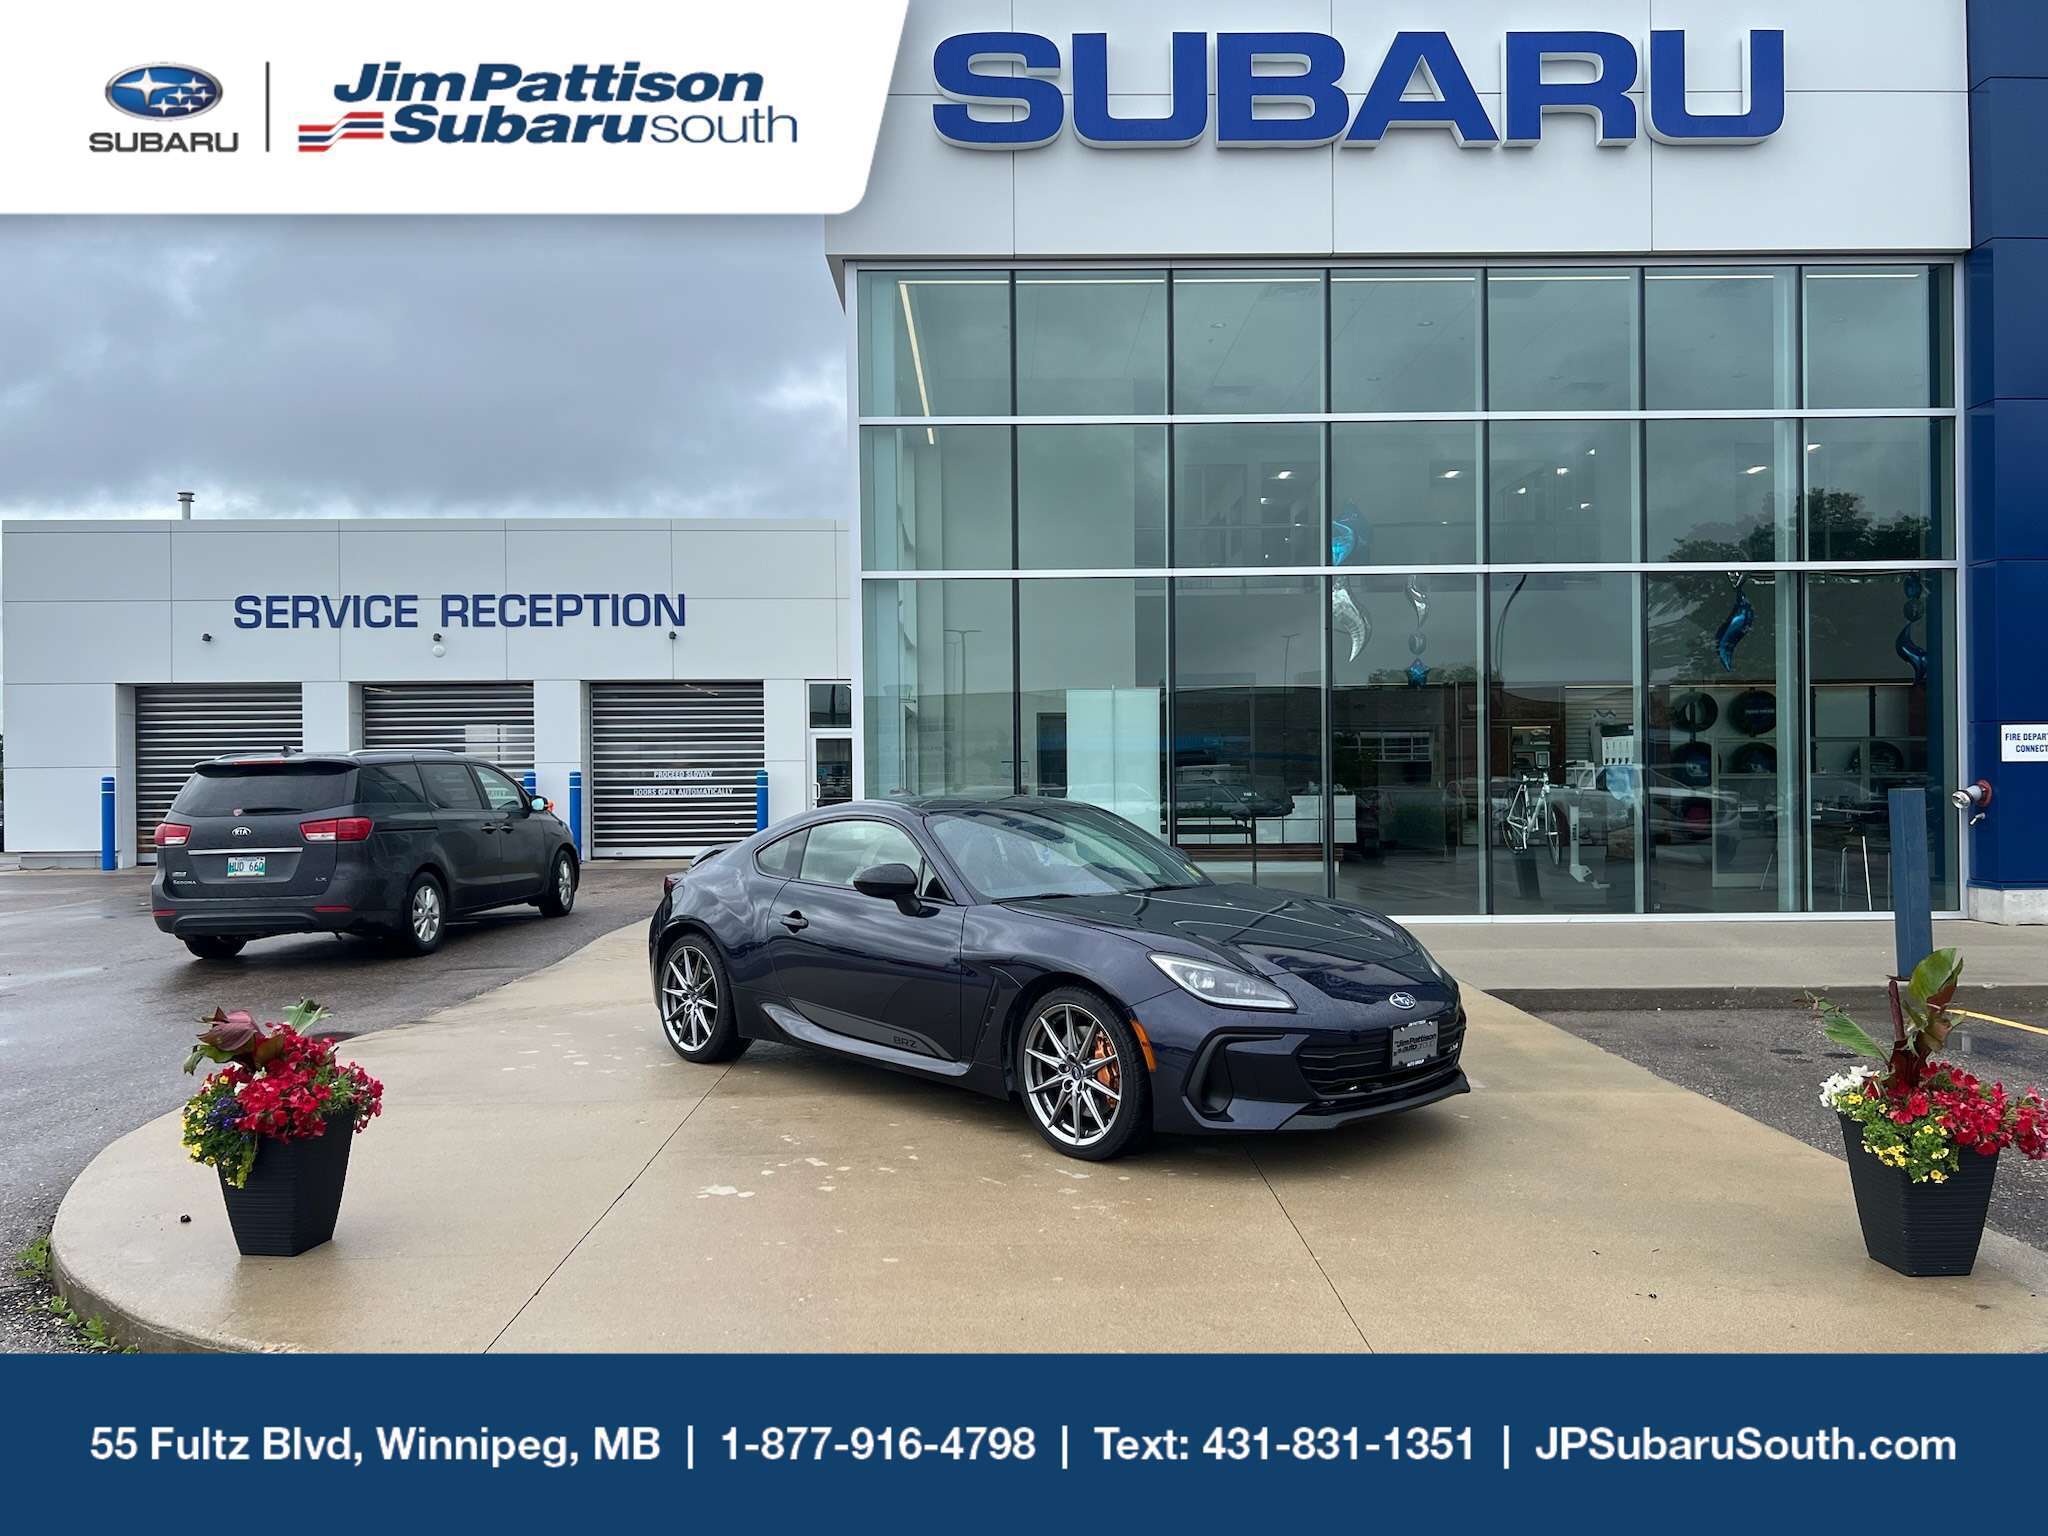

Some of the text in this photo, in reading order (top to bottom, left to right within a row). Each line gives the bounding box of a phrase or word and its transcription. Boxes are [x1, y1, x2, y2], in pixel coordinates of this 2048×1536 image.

[932, 30, 1784, 149] SUBARU
[233, 593, 686, 629] SERVICE RECEPTION
[2005, 732, 2048, 741] FIRE DEPAR
[653, 769, 714, 778] PROCEED SLOWLY
[633, 787, 734, 796] DOORS OPEN AUTOMATICALLY
[893, 1035, 917, 1048] BRZ
